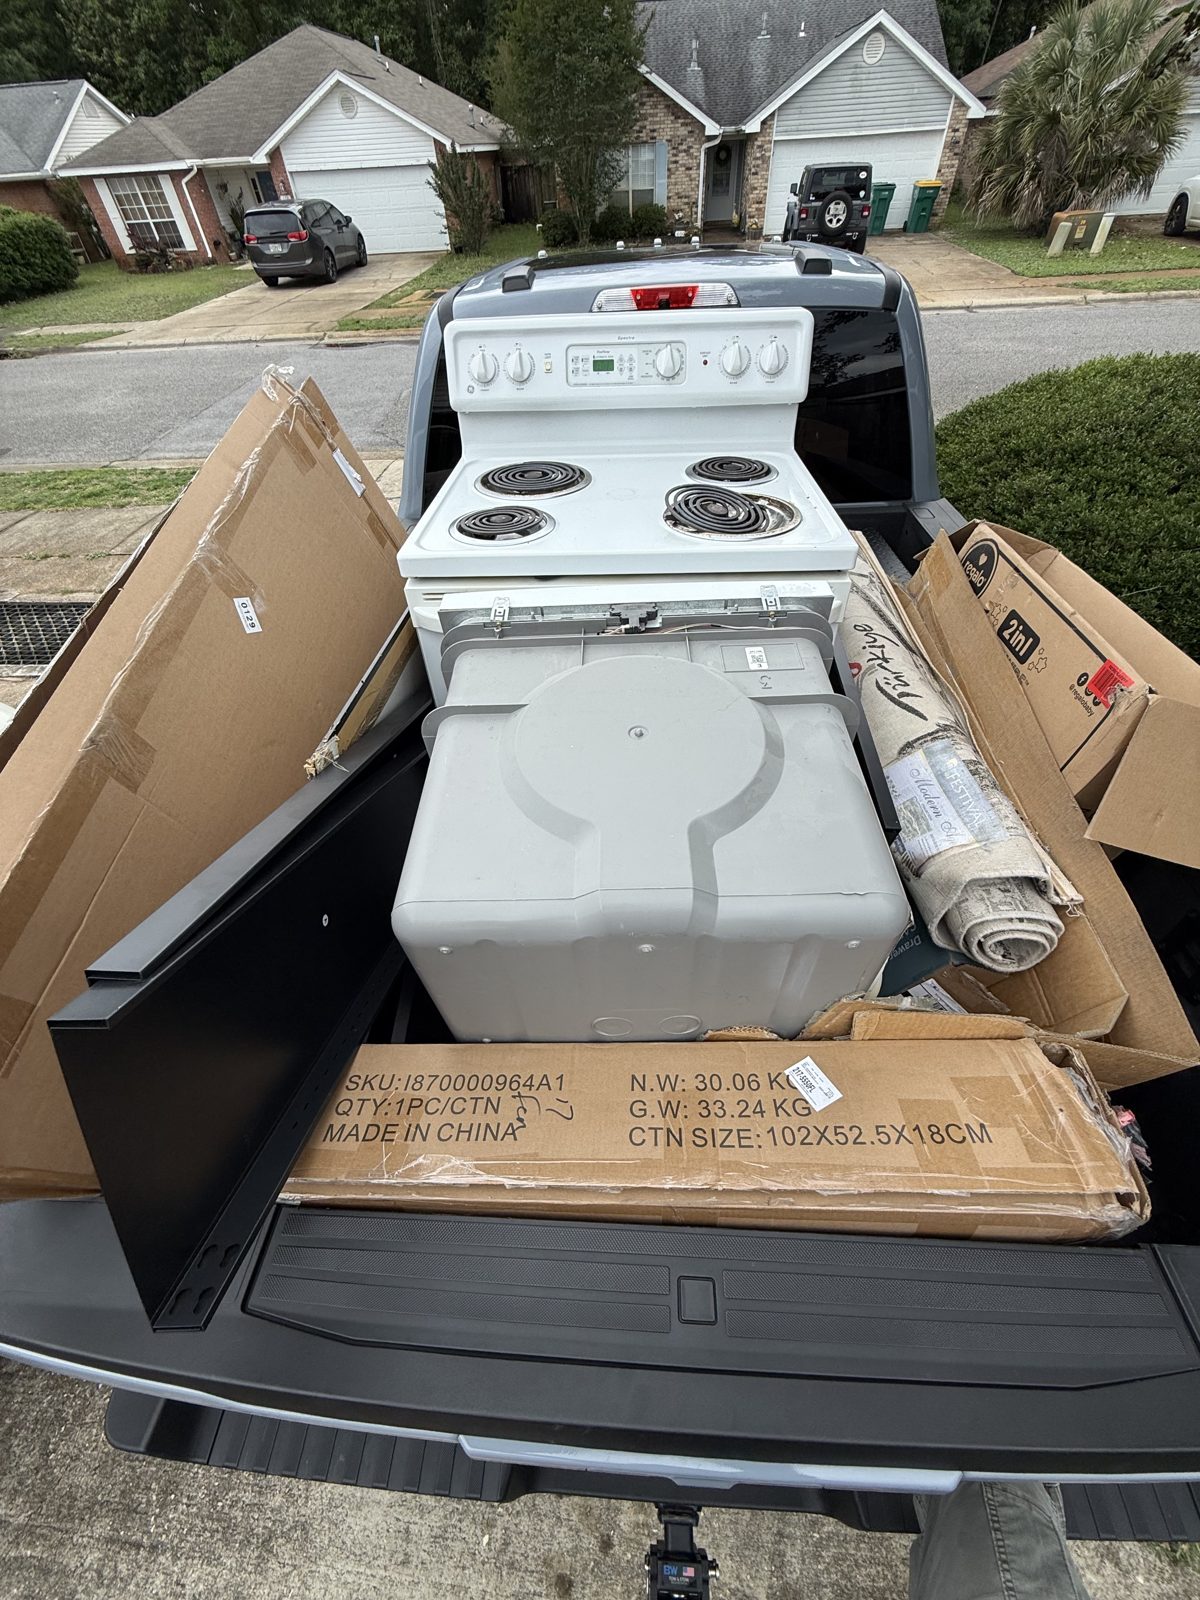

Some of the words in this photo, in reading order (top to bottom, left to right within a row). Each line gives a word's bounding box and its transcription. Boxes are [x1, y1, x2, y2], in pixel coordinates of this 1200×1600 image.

[963, 560, 985, 587] regalo
[240, 602, 256, 628] 0129
[1069, 683, 1094, 717] @regalobaby
[909, 768, 943, 818] Modern
[945, 771, 986, 828] FESTIVAL
[630, 1073, 686, 1093] N.W:
[694, 1072, 761, 1092] 30.06
[335, 1097, 502, 1117] QTY:1PC/CTN
[629, 1099, 689, 1119] G.W:
[697, 1099, 766, 1119] 33.24
[772, 1098, 813, 1118] KG
[322, 1124, 400, 1143] MADE
[403, 1124, 432, 1143] IN
[436, 1123, 520, 1143] CHINA
[628, 1126, 683, 1148] CTN
[663, 1564, 678, 1575] BW
